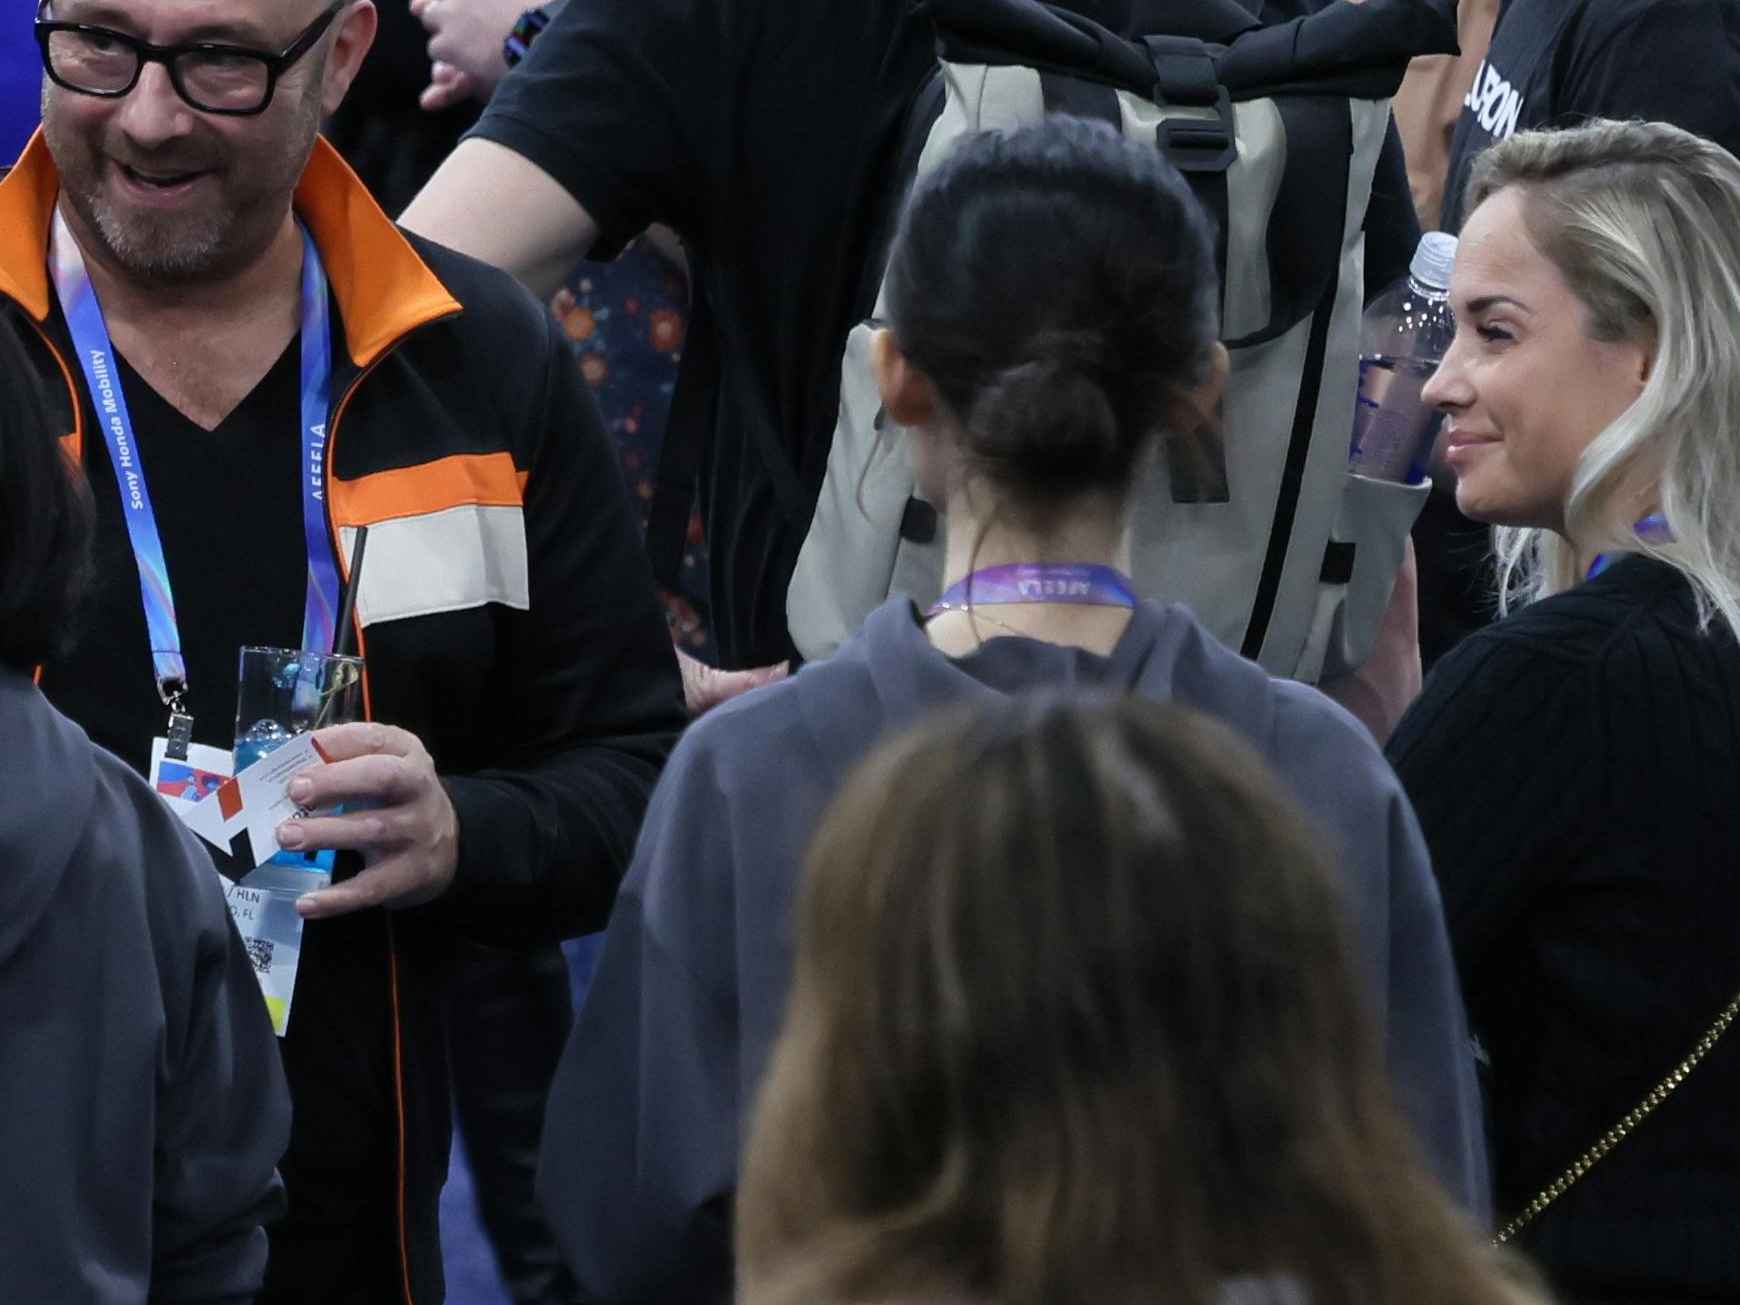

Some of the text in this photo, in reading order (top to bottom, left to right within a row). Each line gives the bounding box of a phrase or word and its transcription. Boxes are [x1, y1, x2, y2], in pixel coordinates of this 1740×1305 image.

[90, 349, 144, 510] Sony Honda Mobility
[236, 889, 260, 903] HLN
[243, 908, 255, 921] FL
